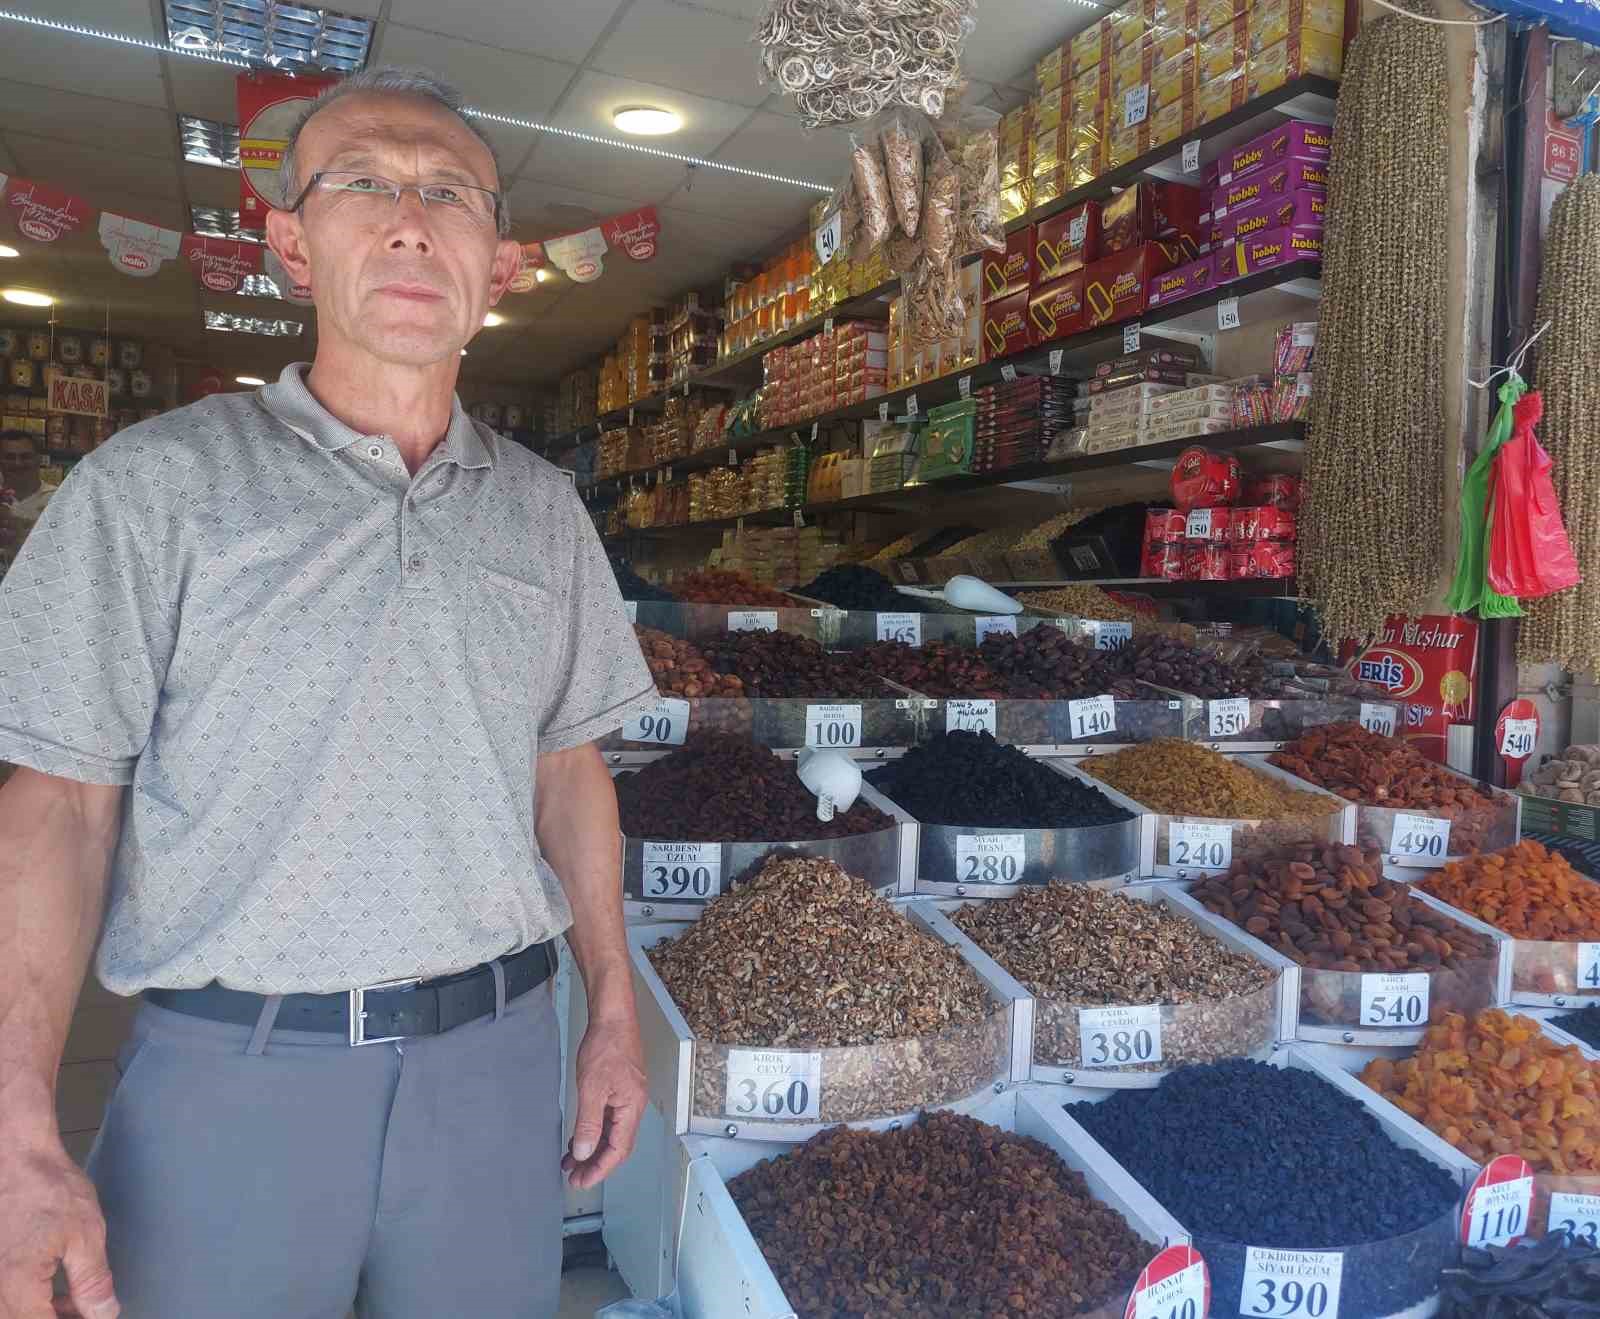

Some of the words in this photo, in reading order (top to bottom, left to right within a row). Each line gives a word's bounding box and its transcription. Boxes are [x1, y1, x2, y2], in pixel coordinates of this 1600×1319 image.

[1303, 133, 1329, 146] hobb
[1551, 143, 1566, 159] 86
[1232, 148, 1264, 172] hobby
[1302, 169, 1327, 182] hobb
[1228, 183, 1261, 205] hobby
[1236, 215, 1270, 235] hobby
[1252, 243, 1282, 260] hobby
[1291, 238, 1321, 249] hobb
[1221, 314, 1236, 328] 150
[53, 379, 106, 414] KASA
[1188, 523, 1207, 536] 150
[883, 626, 915, 646] 165
[639, 715, 672, 742] 90
[815, 721, 855, 746] 100
[1076, 710, 1111, 736] 140
[1214, 713, 1248, 736] 350
[1505, 735, 1532, 753] 540
[1176, 840, 1224, 867] 240
[1398, 831, 1443, 857] 490
[963, 855, 1017, 882] 280
[650, 865, 712, 897] 390
[1369, 995, 1422, 1024] 540
[1091, 1028, 1153, 1064] 380
[735, 1078, 809, 1115] 360
[1479, 1203, 1521, 1242] 110
[1252, 1251, 1325, 1264] ÇEKİRDEKSİZ
[1252, 1278, 1328, 1319] 390
